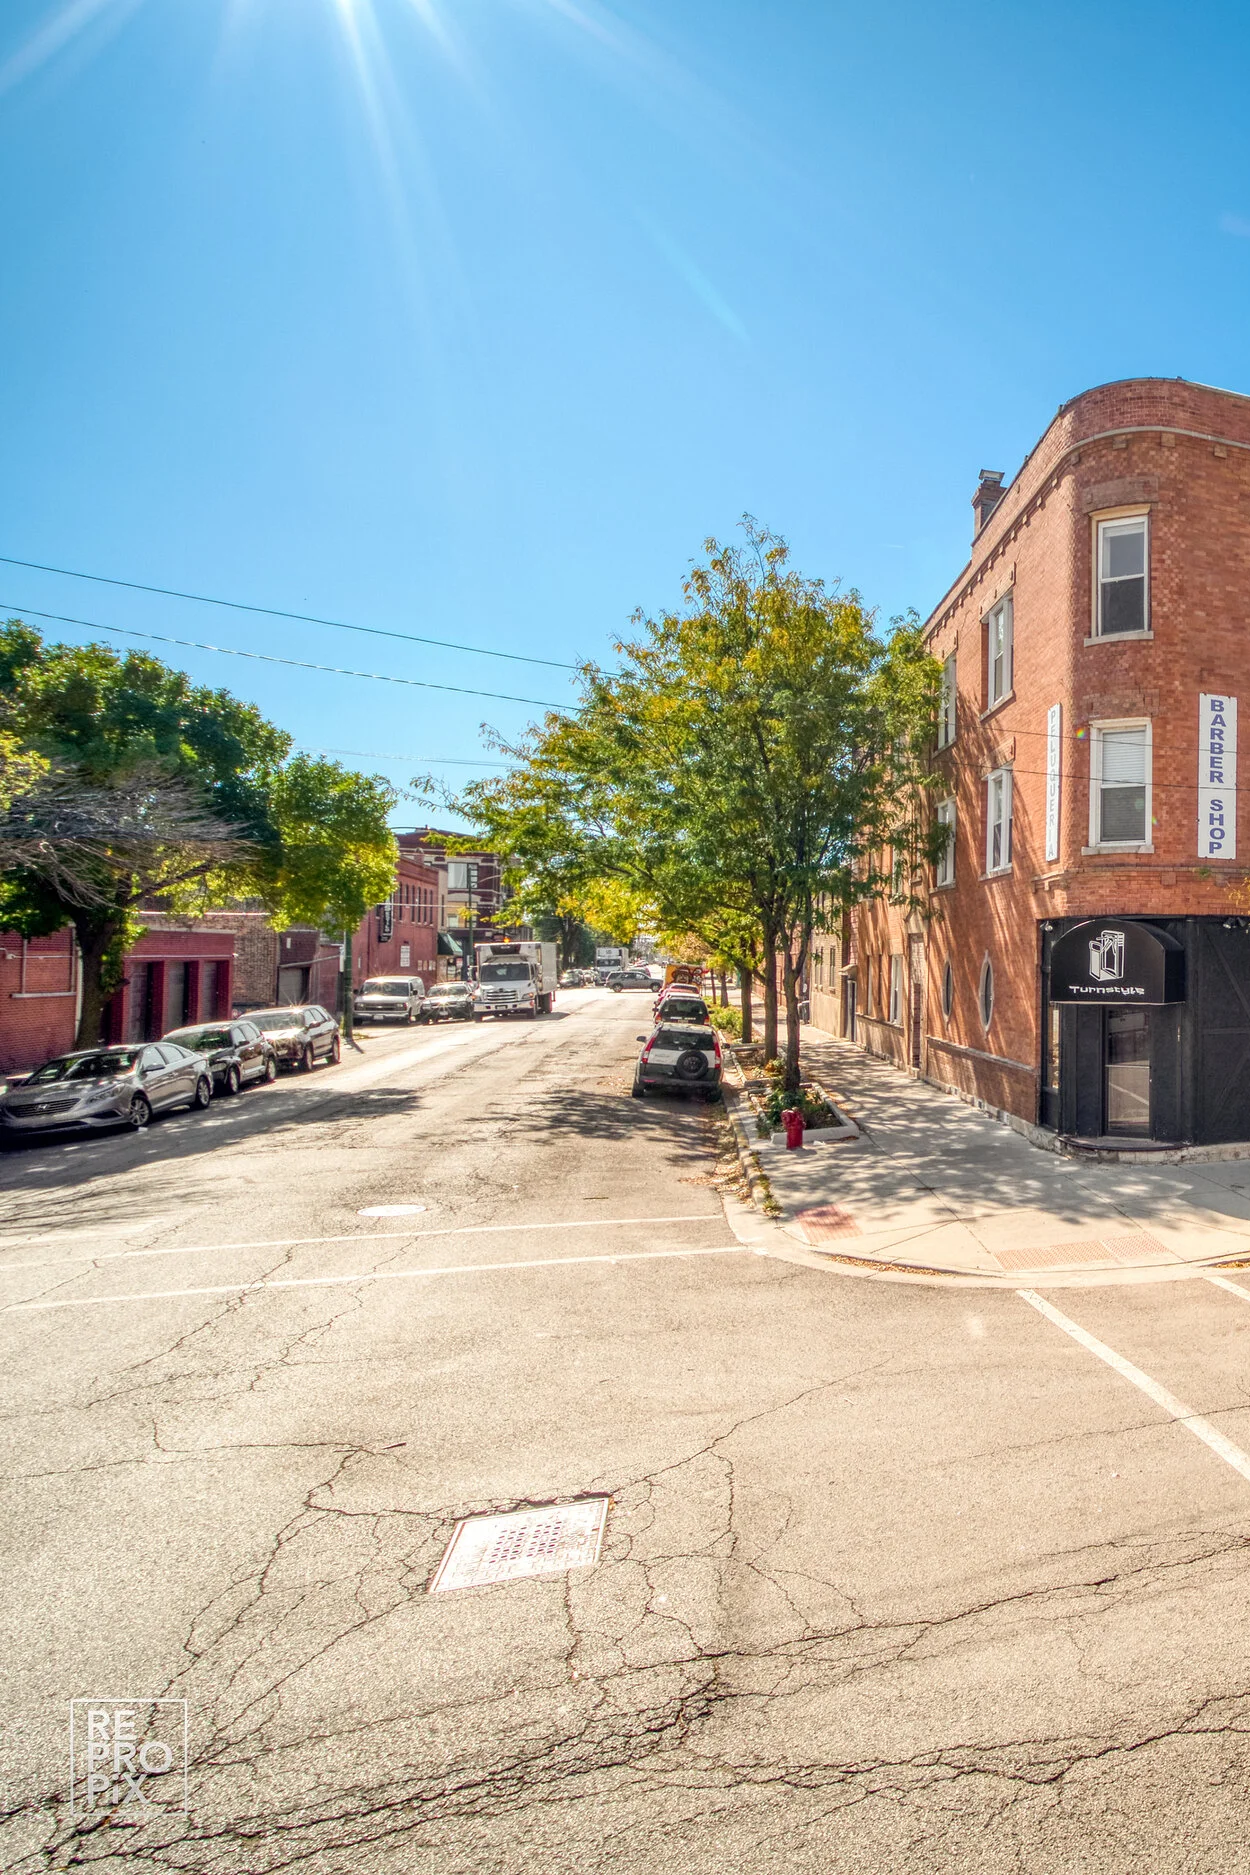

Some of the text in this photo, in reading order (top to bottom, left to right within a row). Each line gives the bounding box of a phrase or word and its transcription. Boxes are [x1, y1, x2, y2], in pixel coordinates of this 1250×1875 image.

[1048, 709, 1057, 858] PELUQUERIA
[1209, 699, 1226, 854] BARBER SHOP
